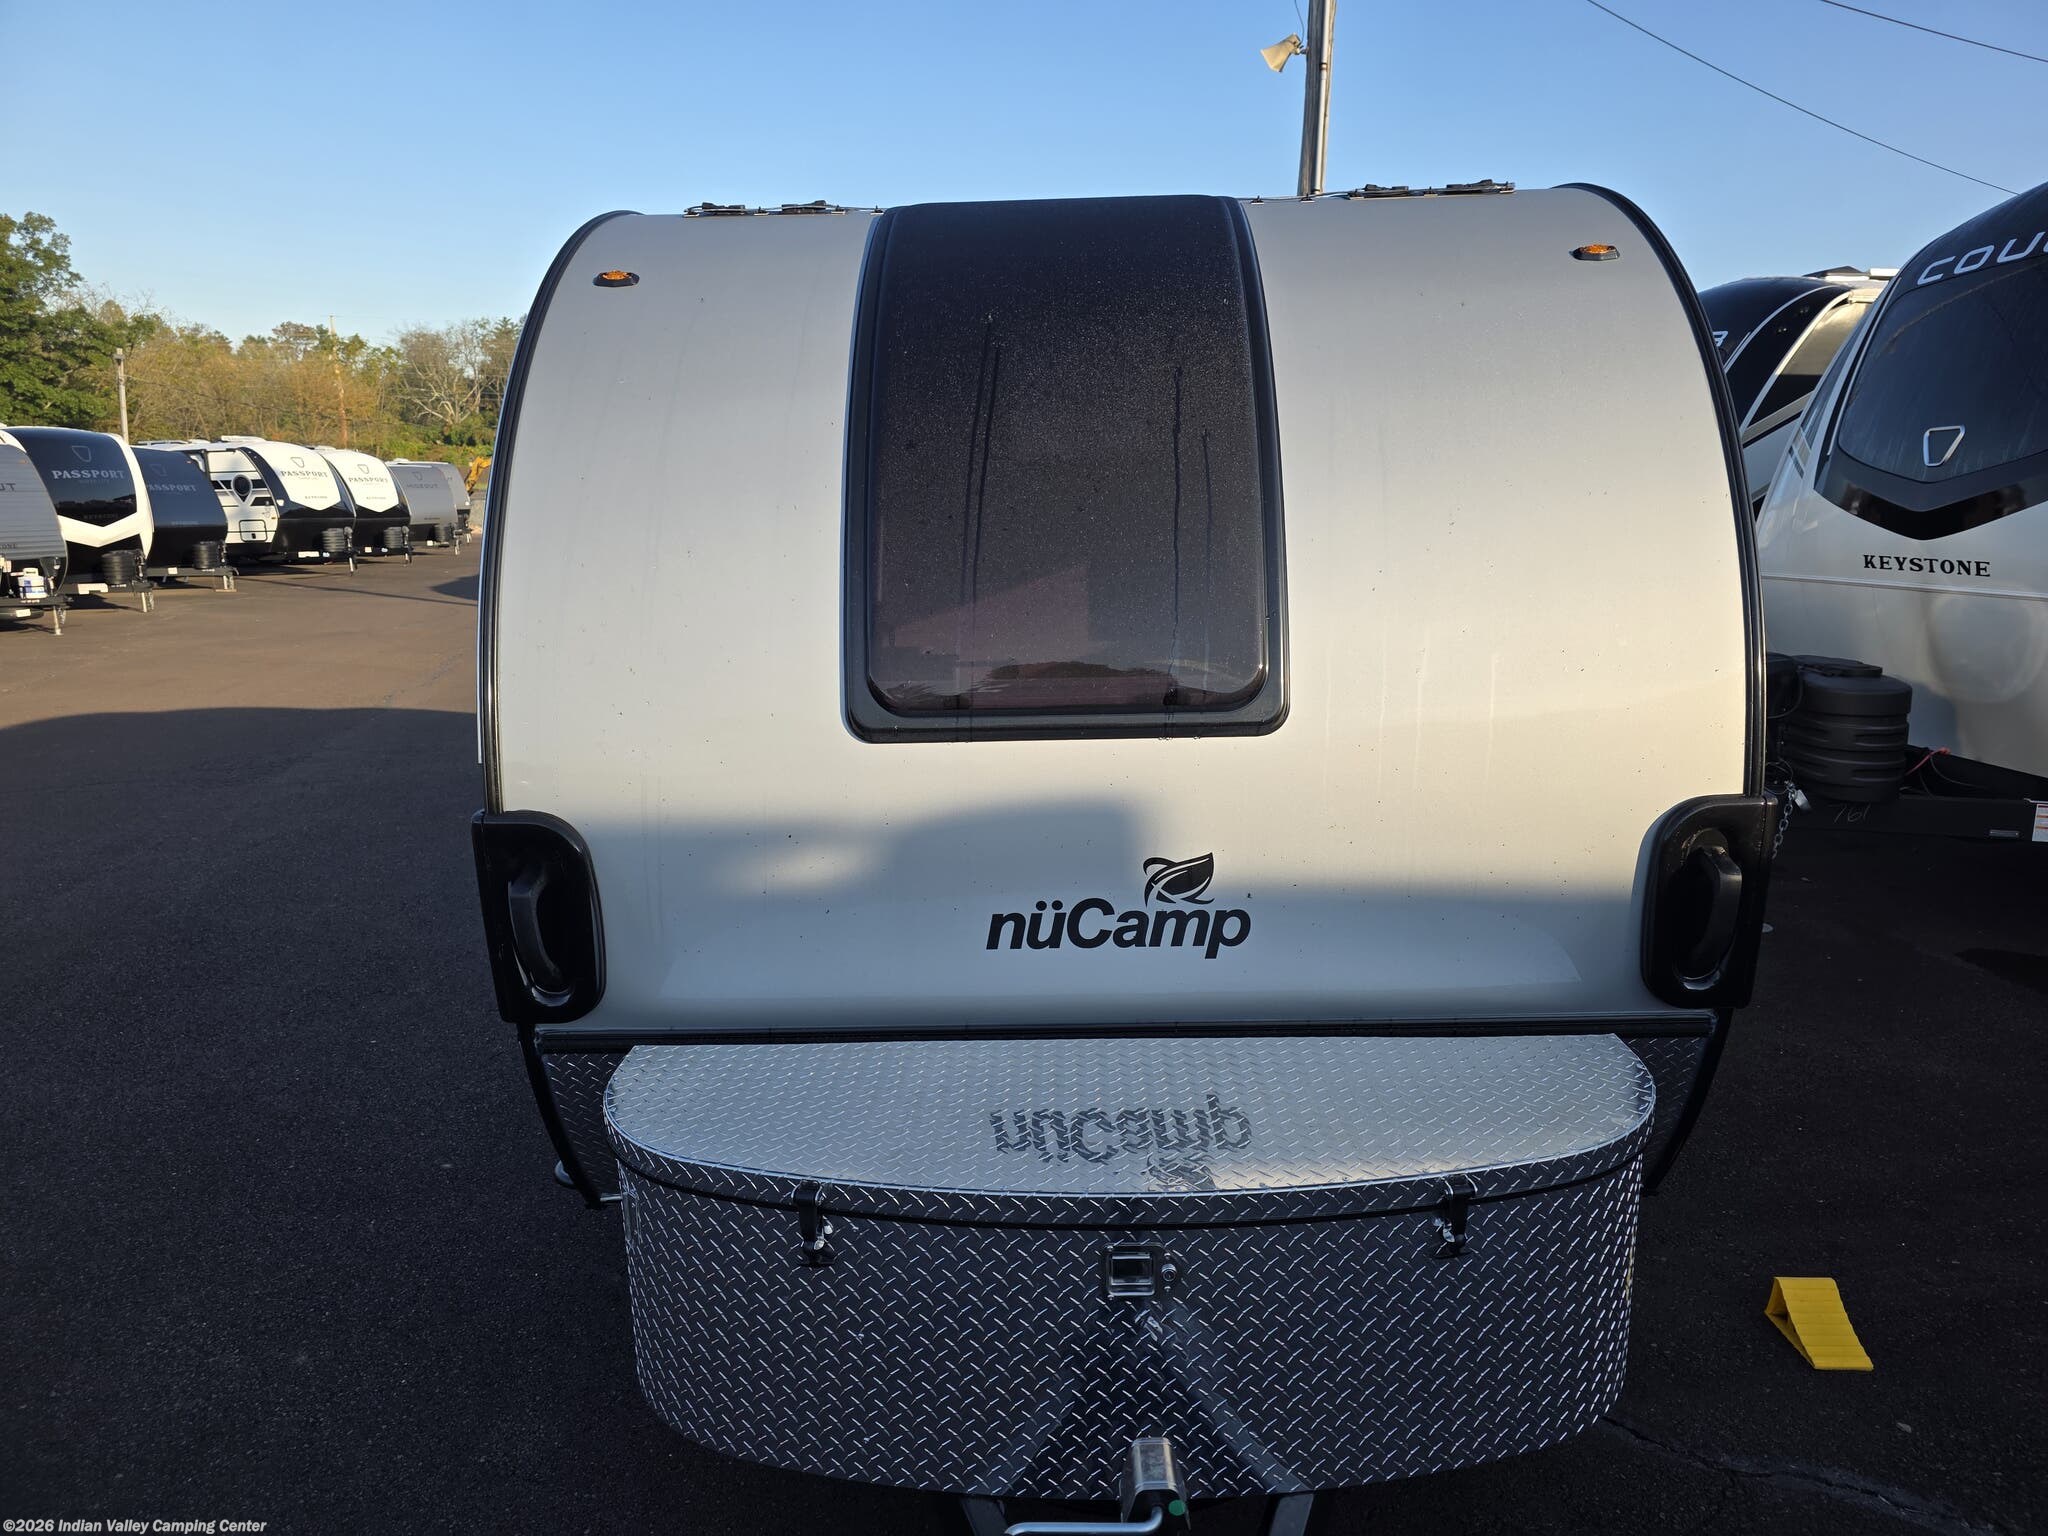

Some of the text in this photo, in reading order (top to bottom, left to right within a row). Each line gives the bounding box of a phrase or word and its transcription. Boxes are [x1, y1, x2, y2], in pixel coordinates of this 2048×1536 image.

[1917, 231, 2048, 286] COU
[51, 470, 125, 480] PASSPORT
[280, 470, 328, 478] PASSPORT
[1863, 554, 1991, 577] KEYSTONE
[986, 897, 1251, 959] nüCamp
